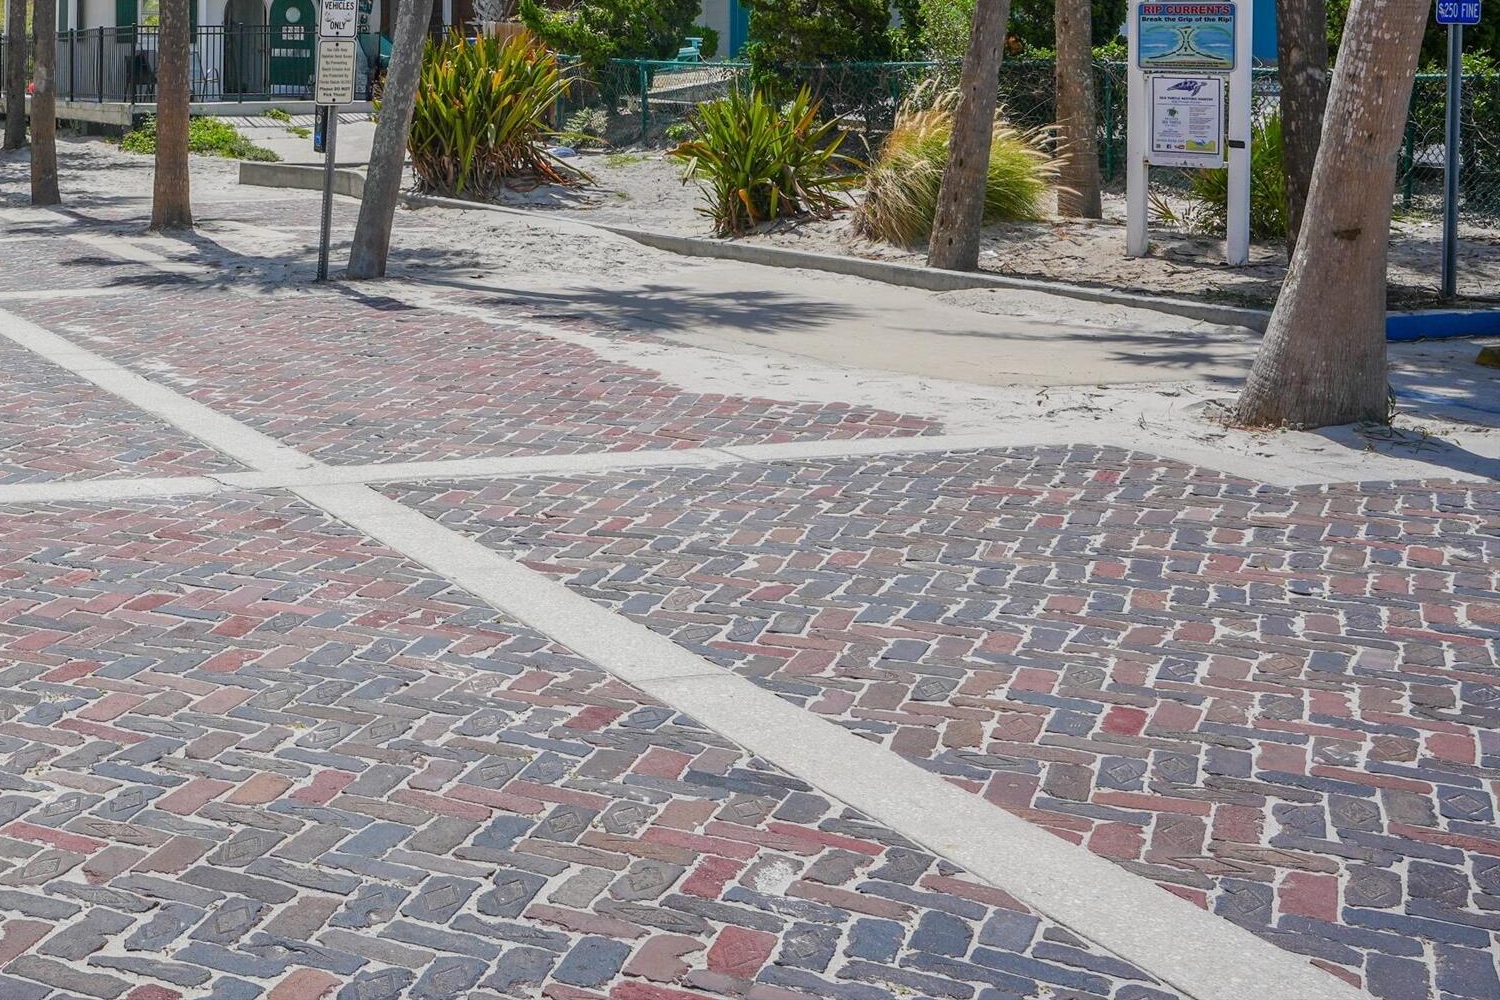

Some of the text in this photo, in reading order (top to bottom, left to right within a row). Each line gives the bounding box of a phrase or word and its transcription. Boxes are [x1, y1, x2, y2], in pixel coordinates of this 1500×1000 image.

[325, 1, 355, 10] VEHICLES
[1143, 5, 1231, 14] RIP CURRENTS
[1461, 3, 1479, 18] FINE
[330, 21, 347, 30] ONLY
